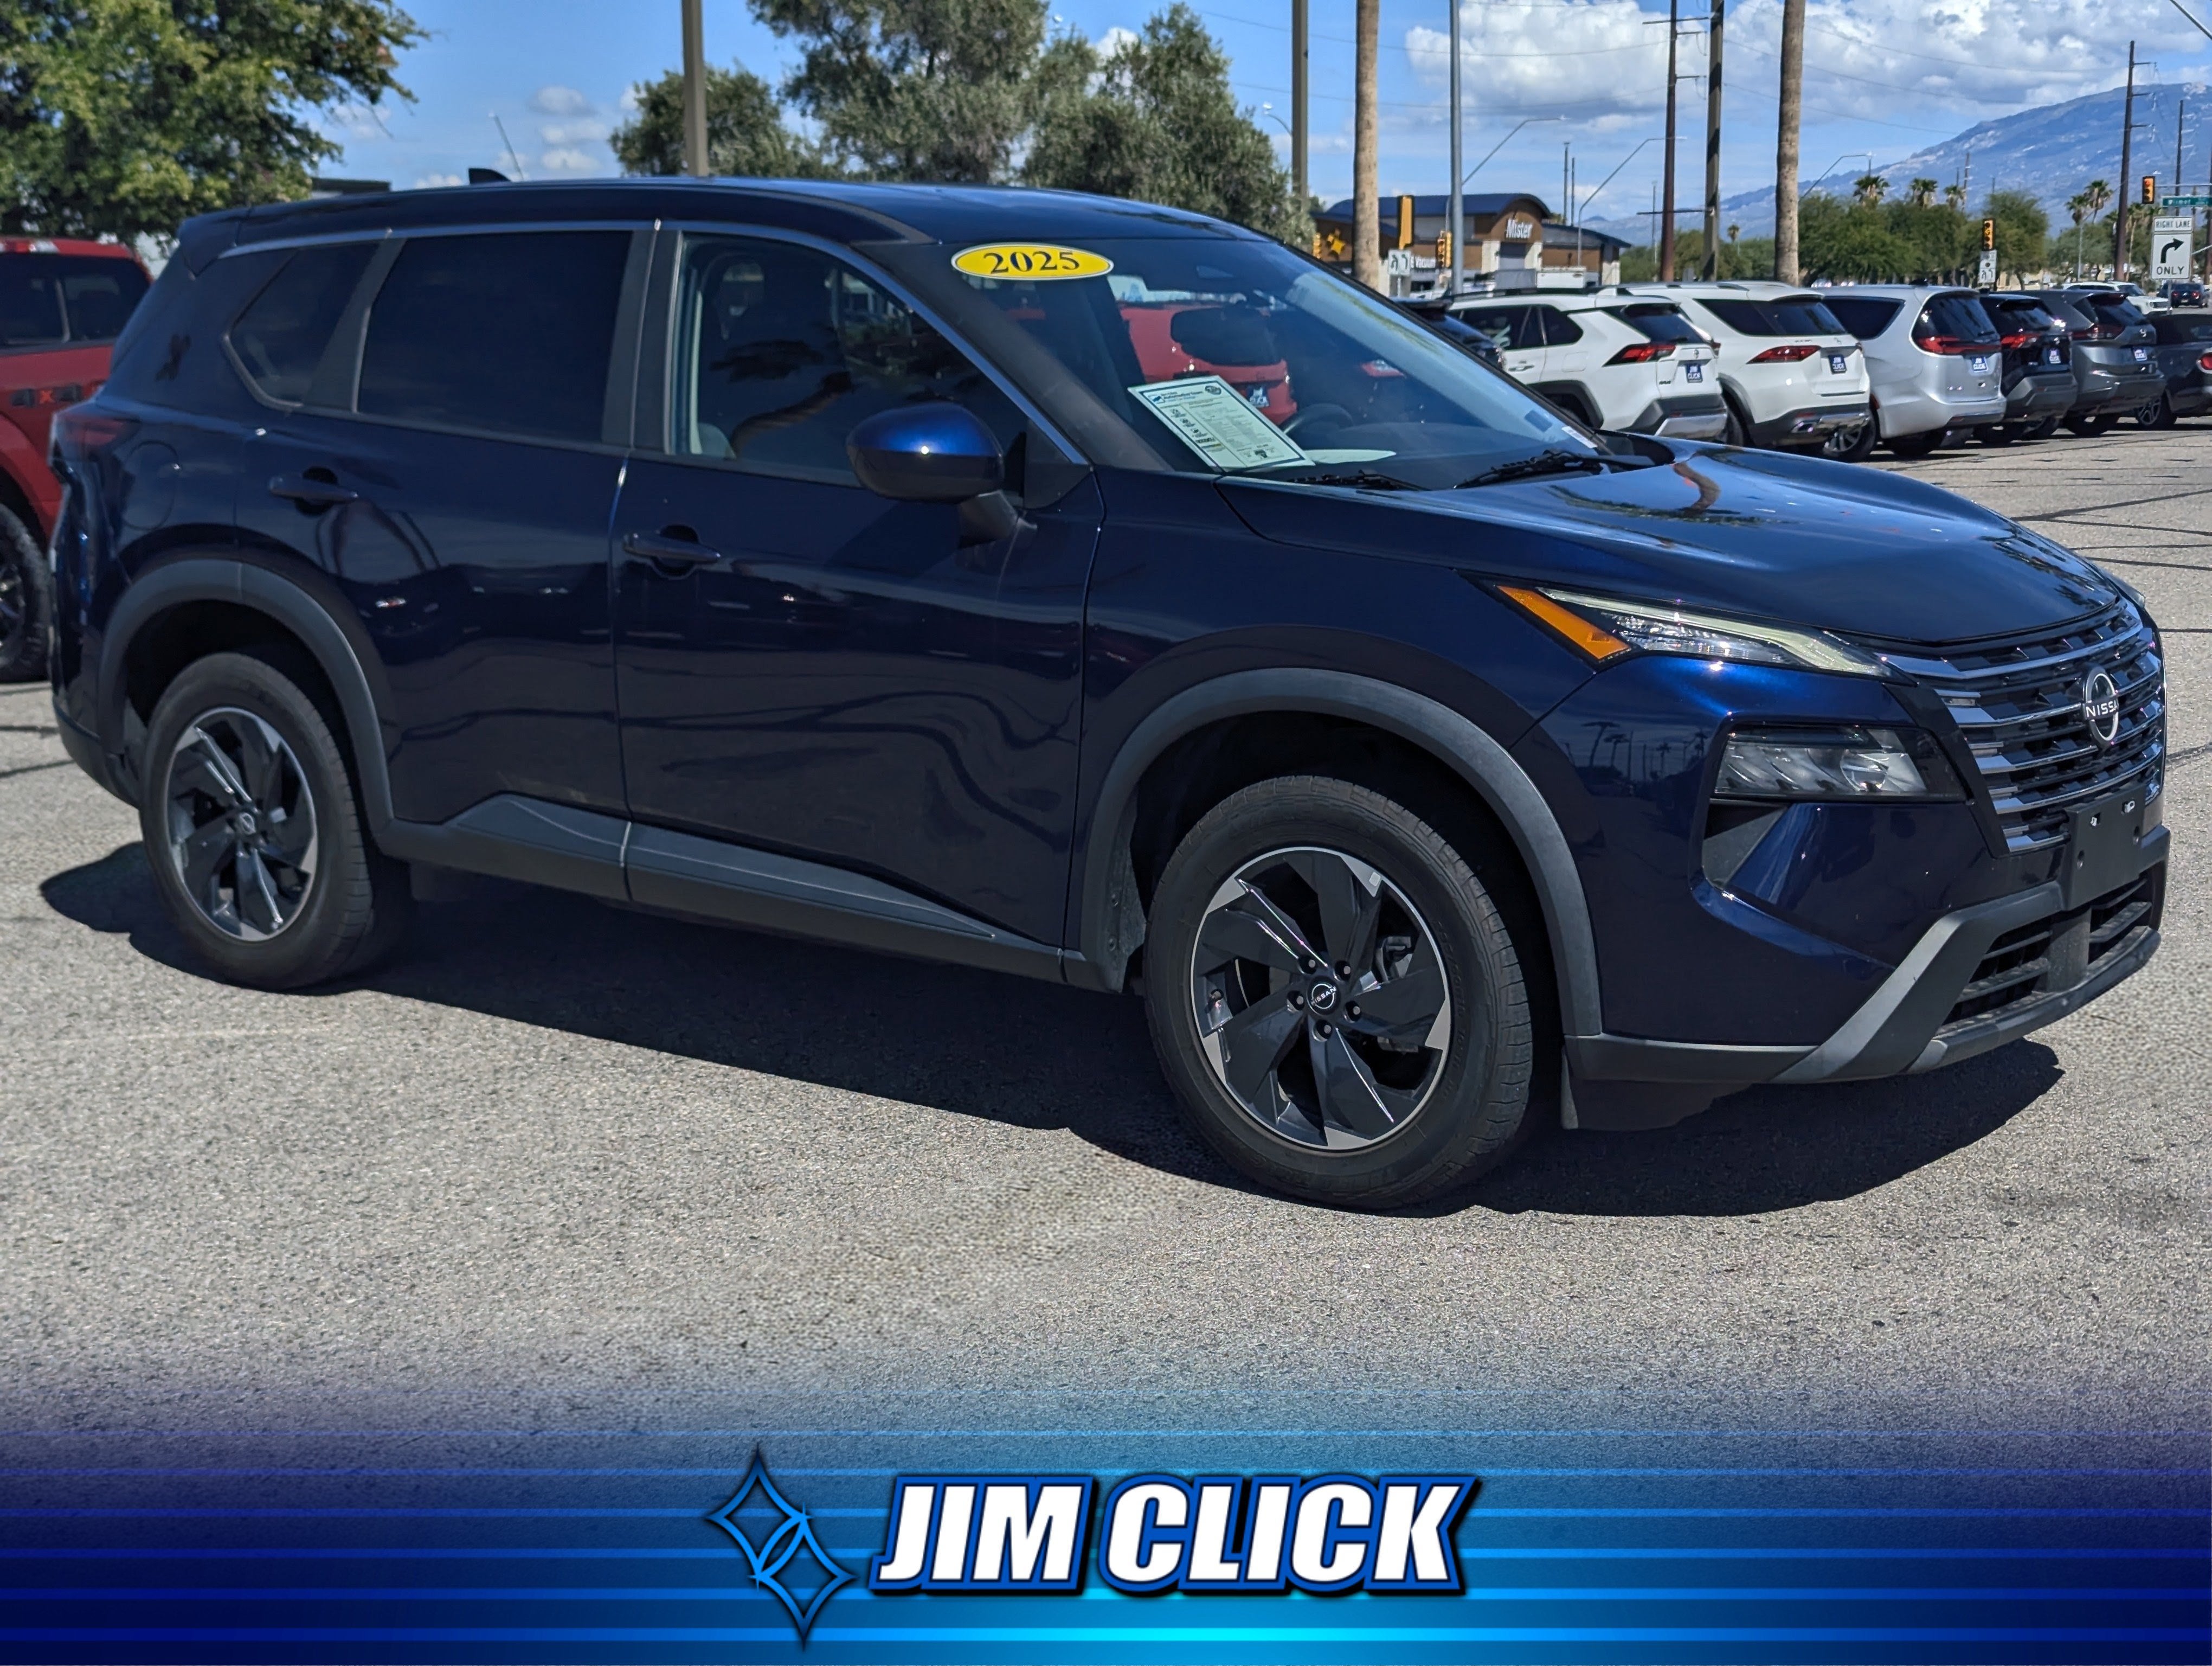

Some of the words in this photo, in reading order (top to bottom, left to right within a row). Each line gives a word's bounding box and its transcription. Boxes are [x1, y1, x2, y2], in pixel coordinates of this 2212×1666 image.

[1506, 219, 1532, 238] Mister
[983, 251, 1079, 274] 2025
[2156, 266, 2184, 275] ONLY
[2086, 700, 2117, 717] NISSA
[1311, 986, 1336, 1005] NISSAN
